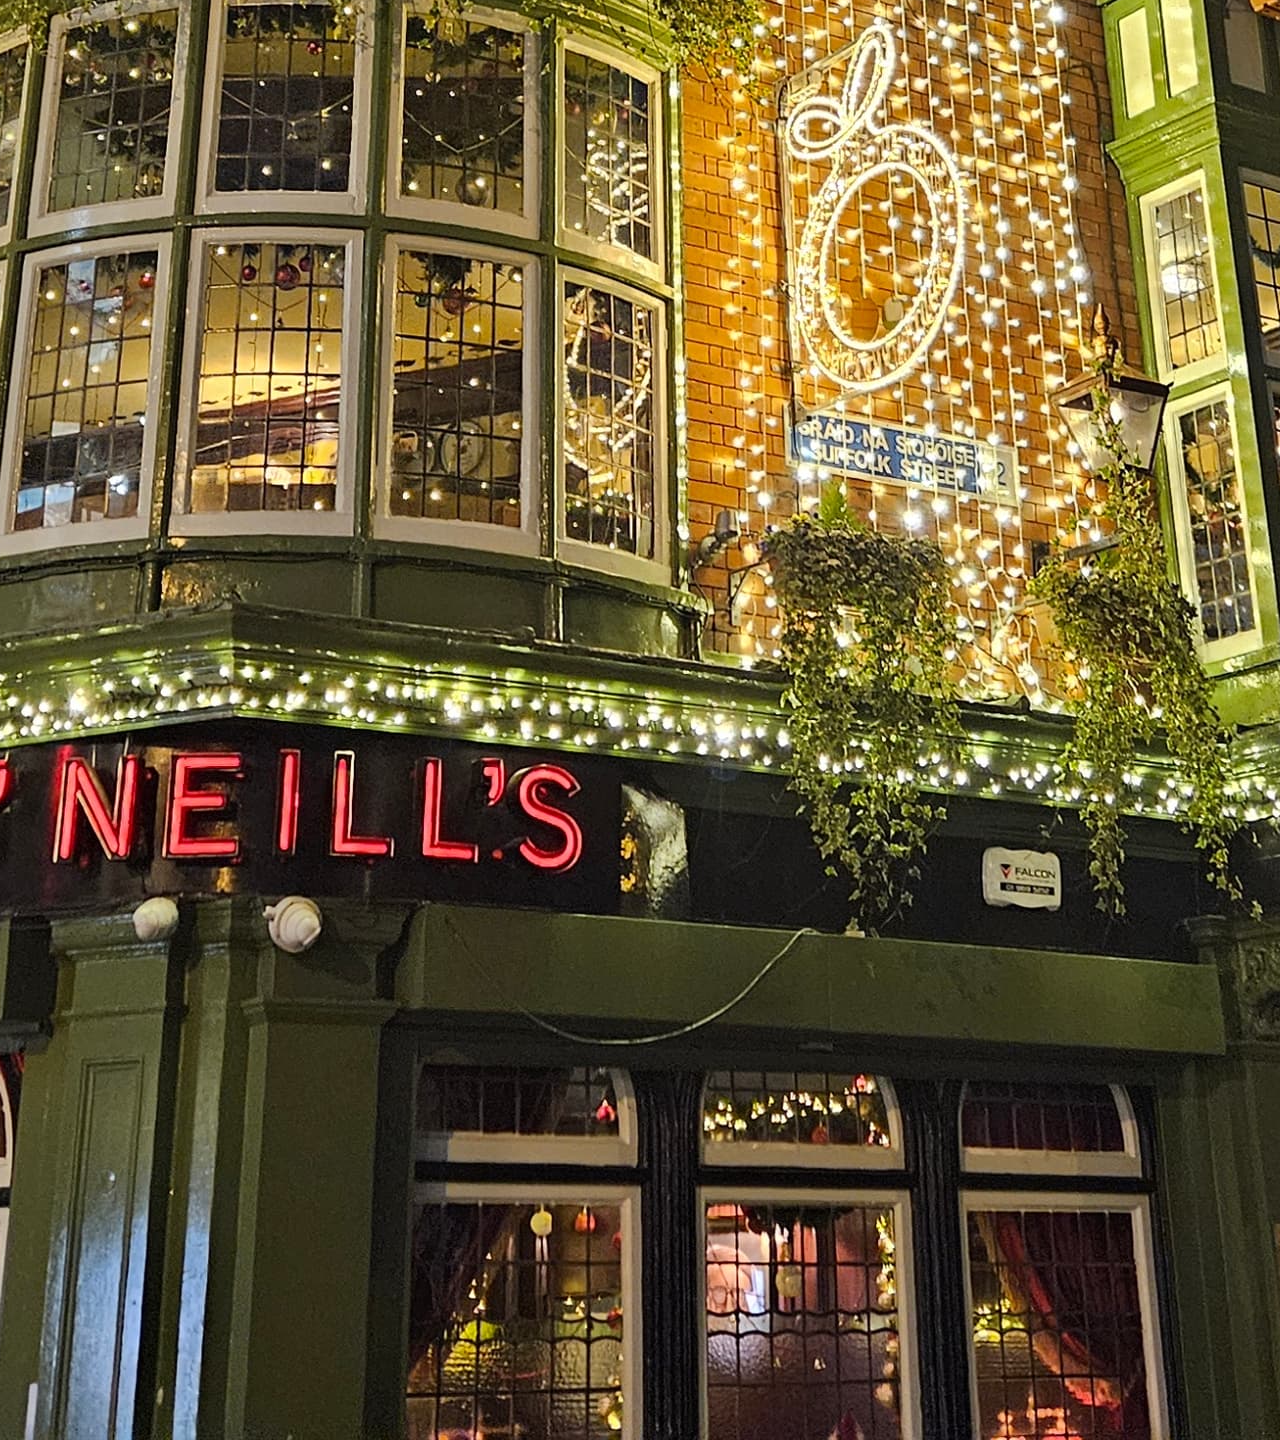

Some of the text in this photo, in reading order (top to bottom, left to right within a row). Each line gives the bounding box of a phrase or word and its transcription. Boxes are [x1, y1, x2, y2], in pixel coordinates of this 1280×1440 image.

[862, 428, 889, 452] NA
[814, 443, 967, 488] SUFFOLK STREET
[1015, 866, 1056, 880] FALCON
